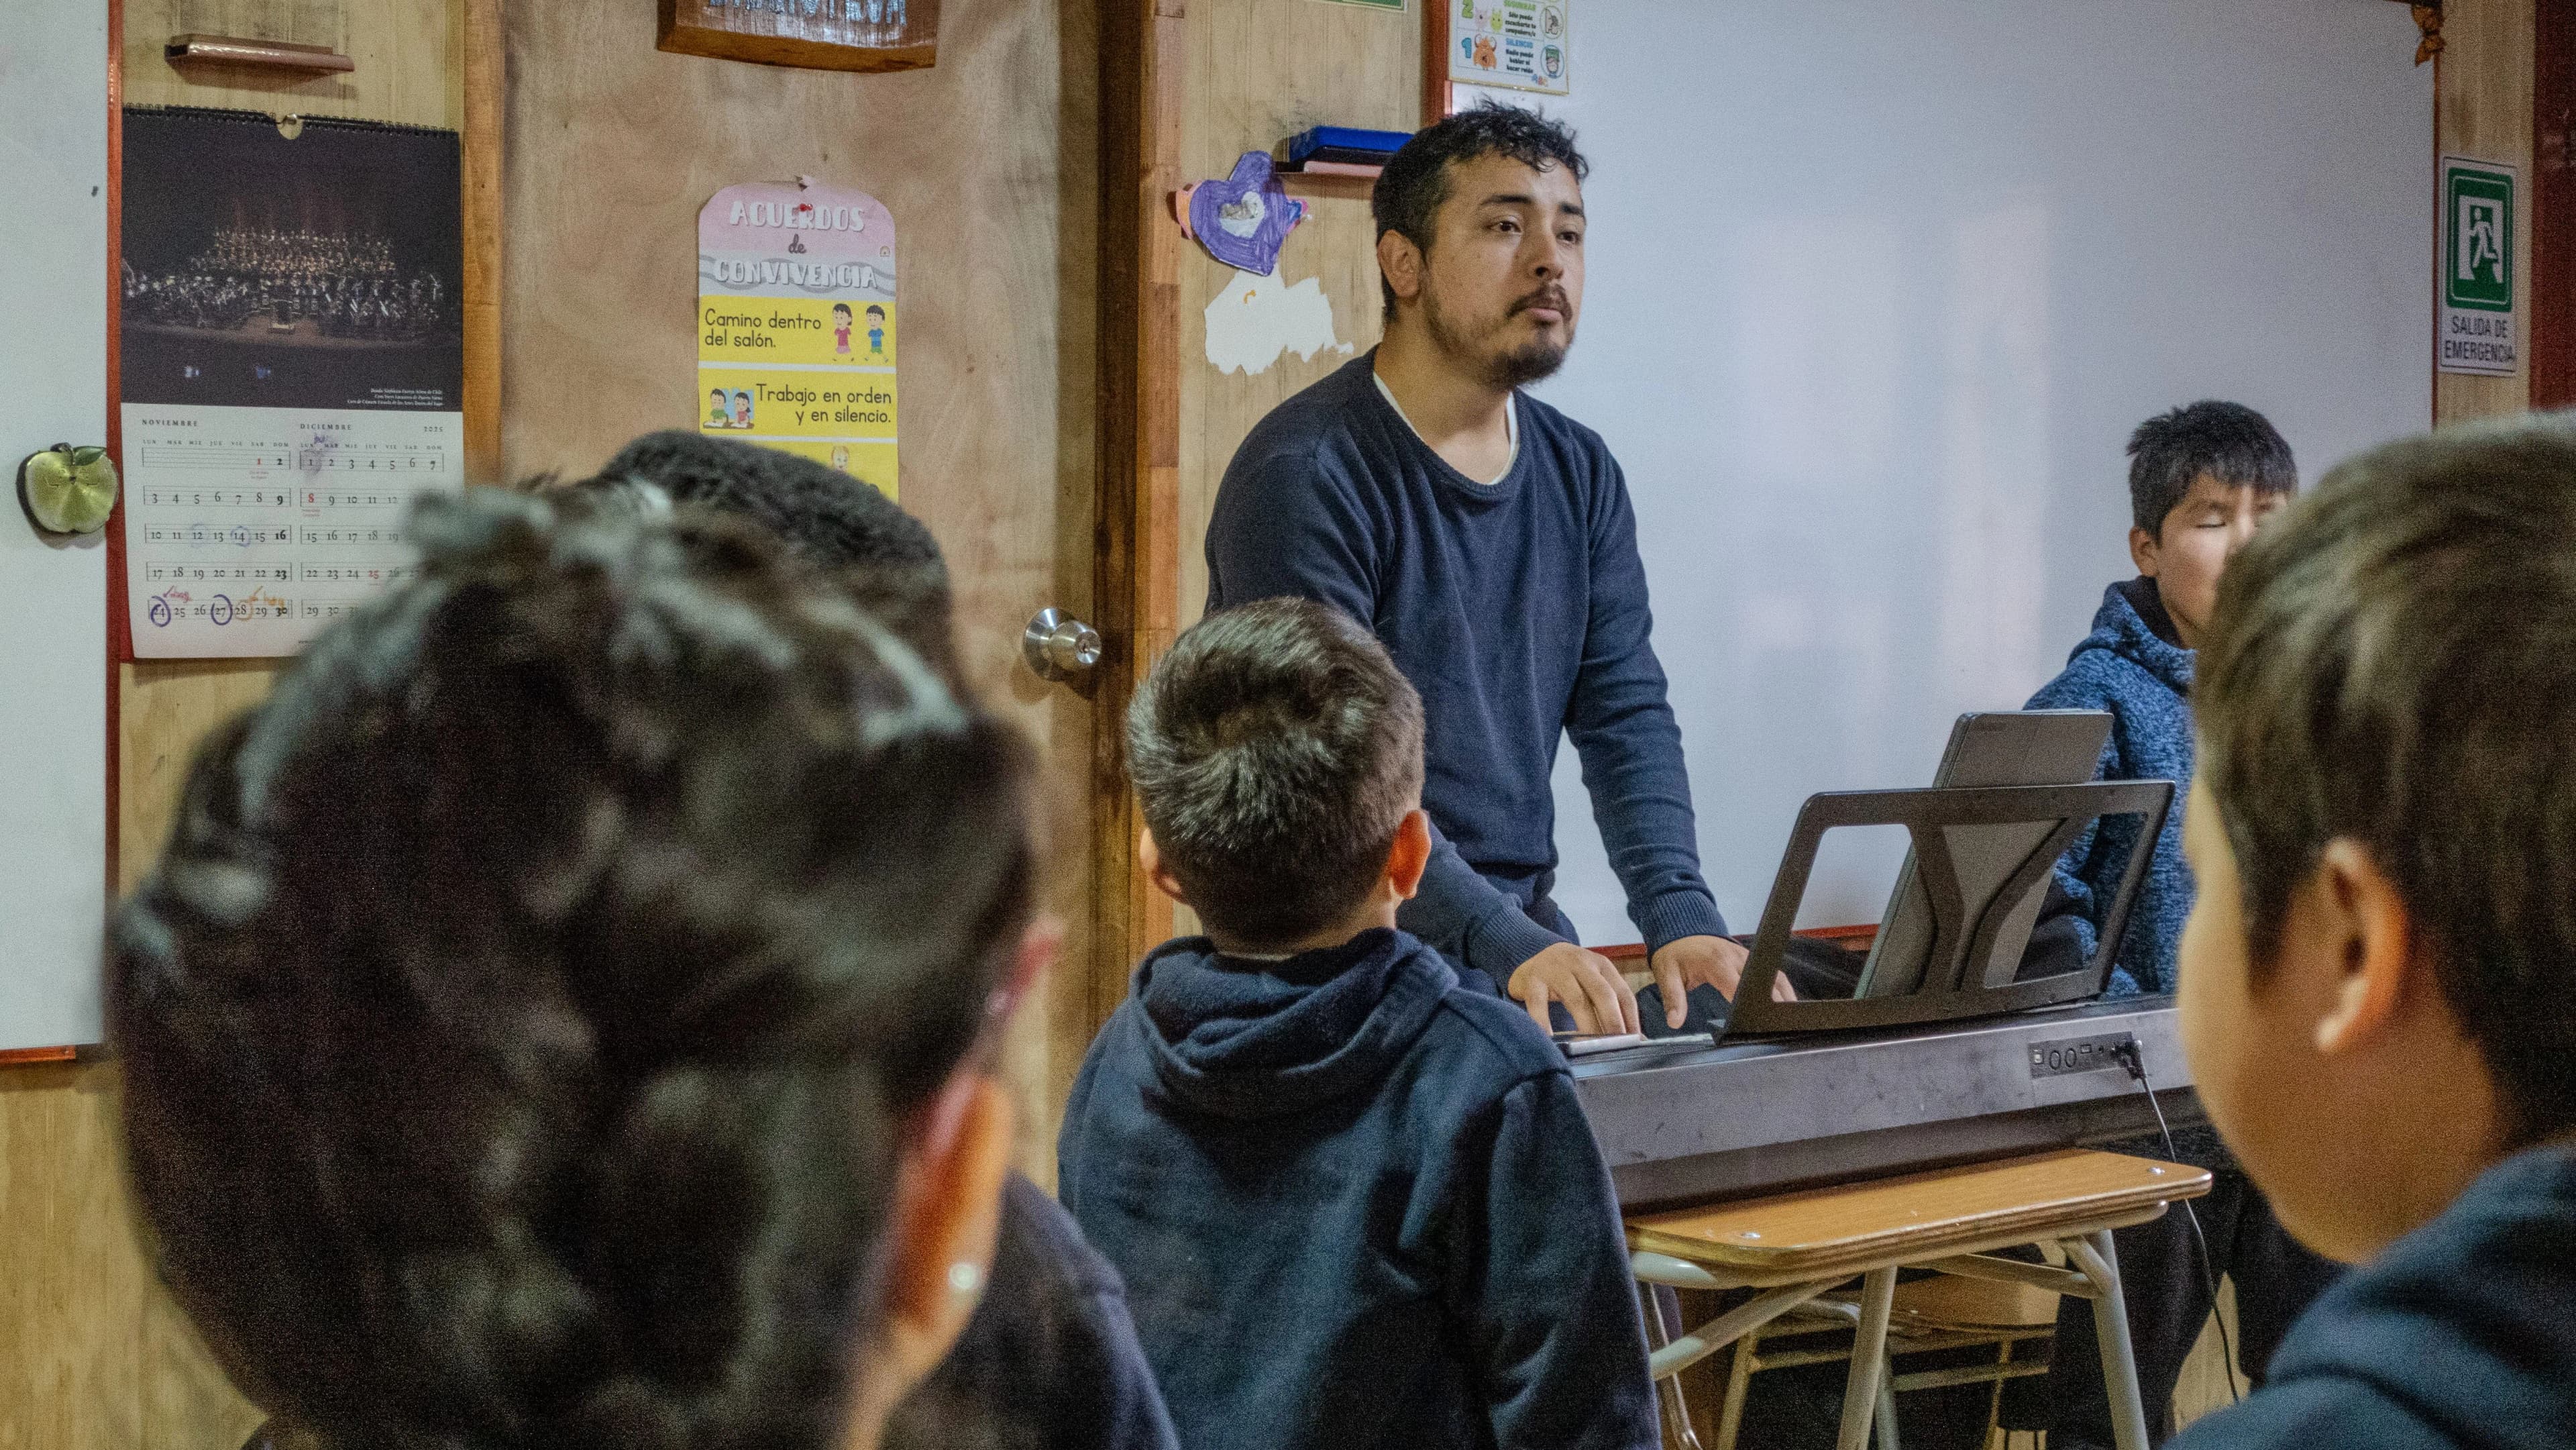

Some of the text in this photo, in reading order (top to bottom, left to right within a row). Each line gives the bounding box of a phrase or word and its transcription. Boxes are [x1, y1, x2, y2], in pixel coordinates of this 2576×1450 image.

[1461, 38, 1472, 58] 1
[1506, 38, 1533, 48] SILENCIO
[729, 201, 865, 232] ACUERDOS
[788, 234, 806, 254] de
[714, 260, 878, 289] CONVIVENCIA
[705, 308, 822, 330] Camino dentro
[2452, 315, 2508, 338] SALIDA DE
[705, 328, 776, 348] del salón.
[2445, 340, 2514, 363] EMERGENCIA
[756, 383, 892, 407] Trabajo en orden
[796, 405, 891, 425] y en silencio.
[142, 419, 198, 427] NOVIEMBRE
[349, 460, 354, 469] 3
[369, 460, 374, 469] 4
[390, 461, 395, 470] 5
[410, 458, 415, 467] 6
[152, 491, 282, 505] 3 4 5 6 7 8 9
[308, 493, 314, 503] 8
[329, 496, 334, 505] 9
[214, 532, 223, 542] 13
[235, 533, 245, 542] 14
[255, 533, 265, 542] 15
[275, 529, 286, 539] 16
[307, 533, 317, 543] 15
[327, 530, 337, 540] 16
[347, 533, 358, 542] 17
[368, 531, 378, 540] 18
[153, 570, 162, 580] 17
[173, 567, 183, 577] 18
[194, 570, 204, 580] 19
[275, 570, 286, 579] 23
[327, 570, 338, 579] 23
[347, 570, 359, 578] 24
[369, 570, 379, 579] 25
[154, 605, 287, 618] 24 25 26 27 28 29 30
[307, 607, 318, 617] 29
[327, 607, 339, 617] 30
